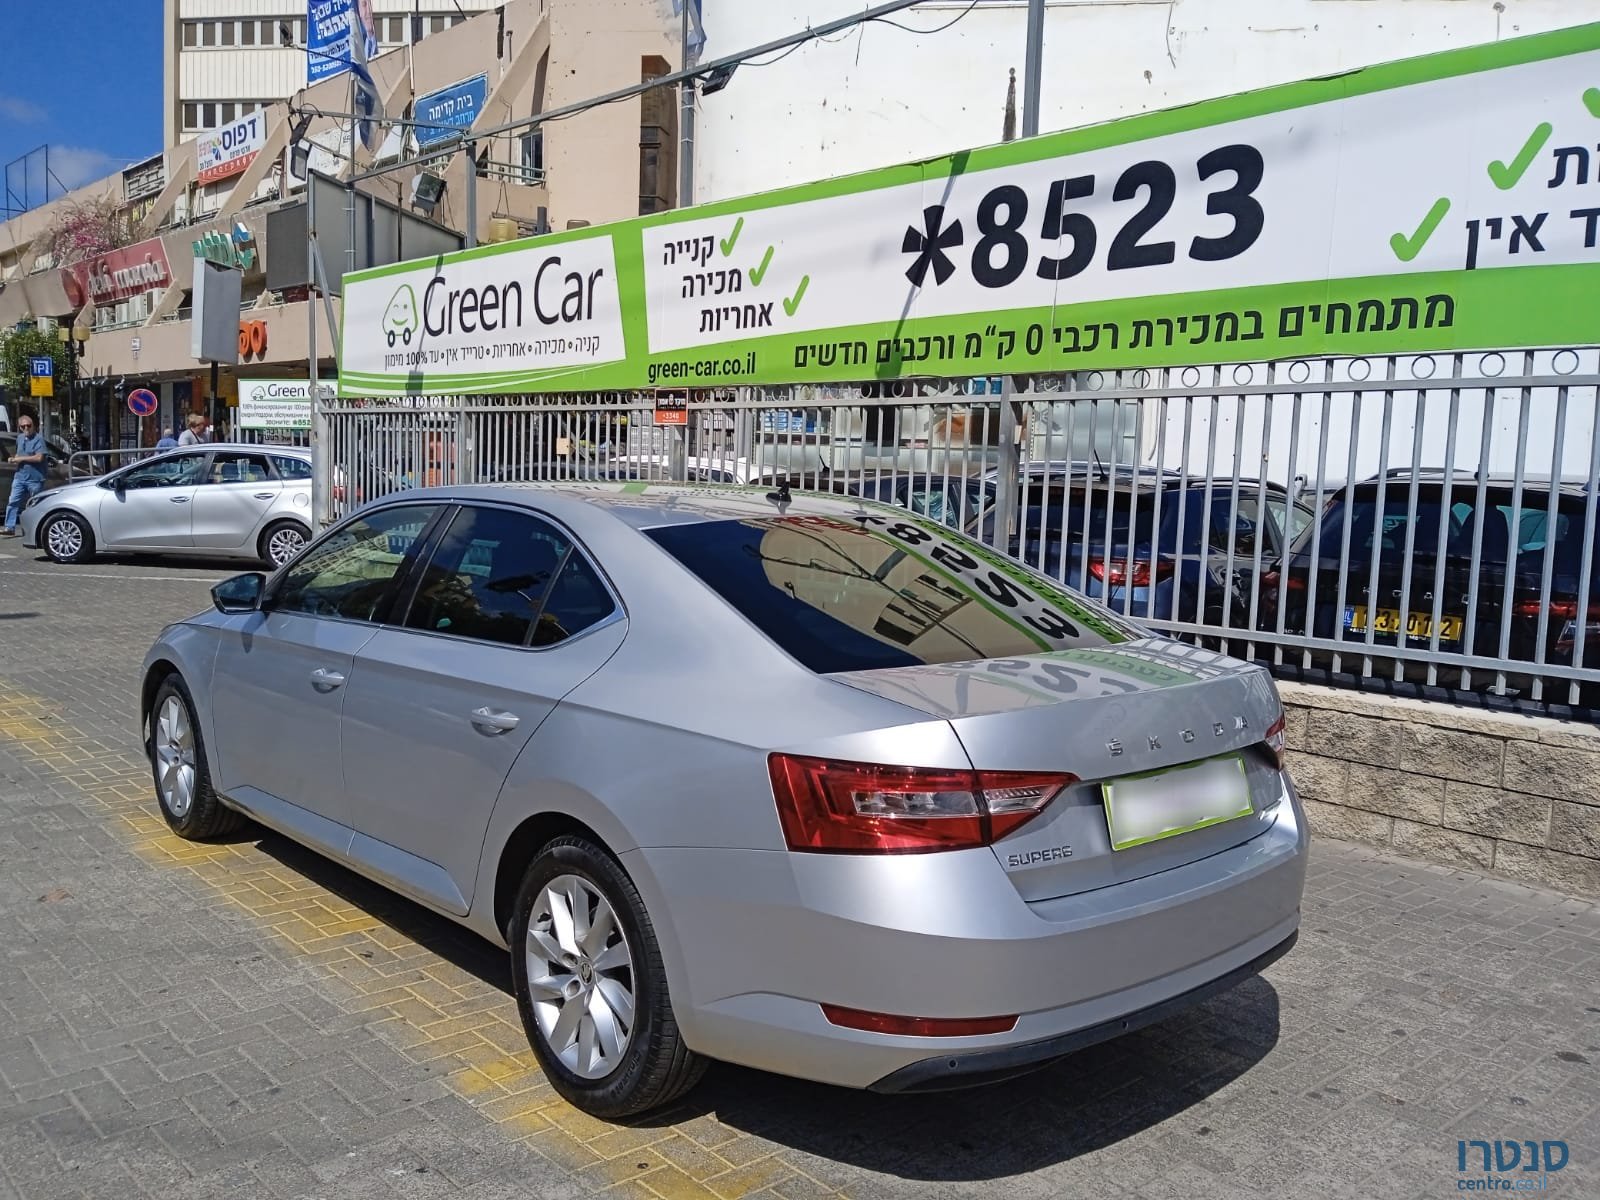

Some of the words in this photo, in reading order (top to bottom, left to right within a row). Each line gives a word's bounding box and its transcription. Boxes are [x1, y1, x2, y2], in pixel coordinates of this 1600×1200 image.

[457, 94, 473, 111] בית
[222, 118, 257, 150] דפוס
[663, 235, 714, 267] קנייה
[1465, 211, 1549, 270] אין
[424, 276, 522, 337] Green
[533, 256, 604, 325] Car
[682, 268, 742, 298] מכירה
[700, 302, 774, 332] אחריות
[1128, 310, 1264, 349] במכירת
[1278, 293, 1455, 338] מתמחים
[492, 342, 526, 359] אחריות
[534, 338, 566, 354] מכירה
[575, 335, 600, 356] קניה
[876, 333, 955, 364] ורכבים
[1053, 322, 1119, 354] רכבי
[385, 353, 404, 371] מימון
[406, 351, 428, 366] 100%
[430, 349, 440, 363] עד
[446, 347, 458, 365] אין
[461, 345, 484, 361] טרייד
[794, 341, 868, 368] חדשים
[648, 352, 756, 383] green-car.co.il
[268, 384, 305, 397] Green
